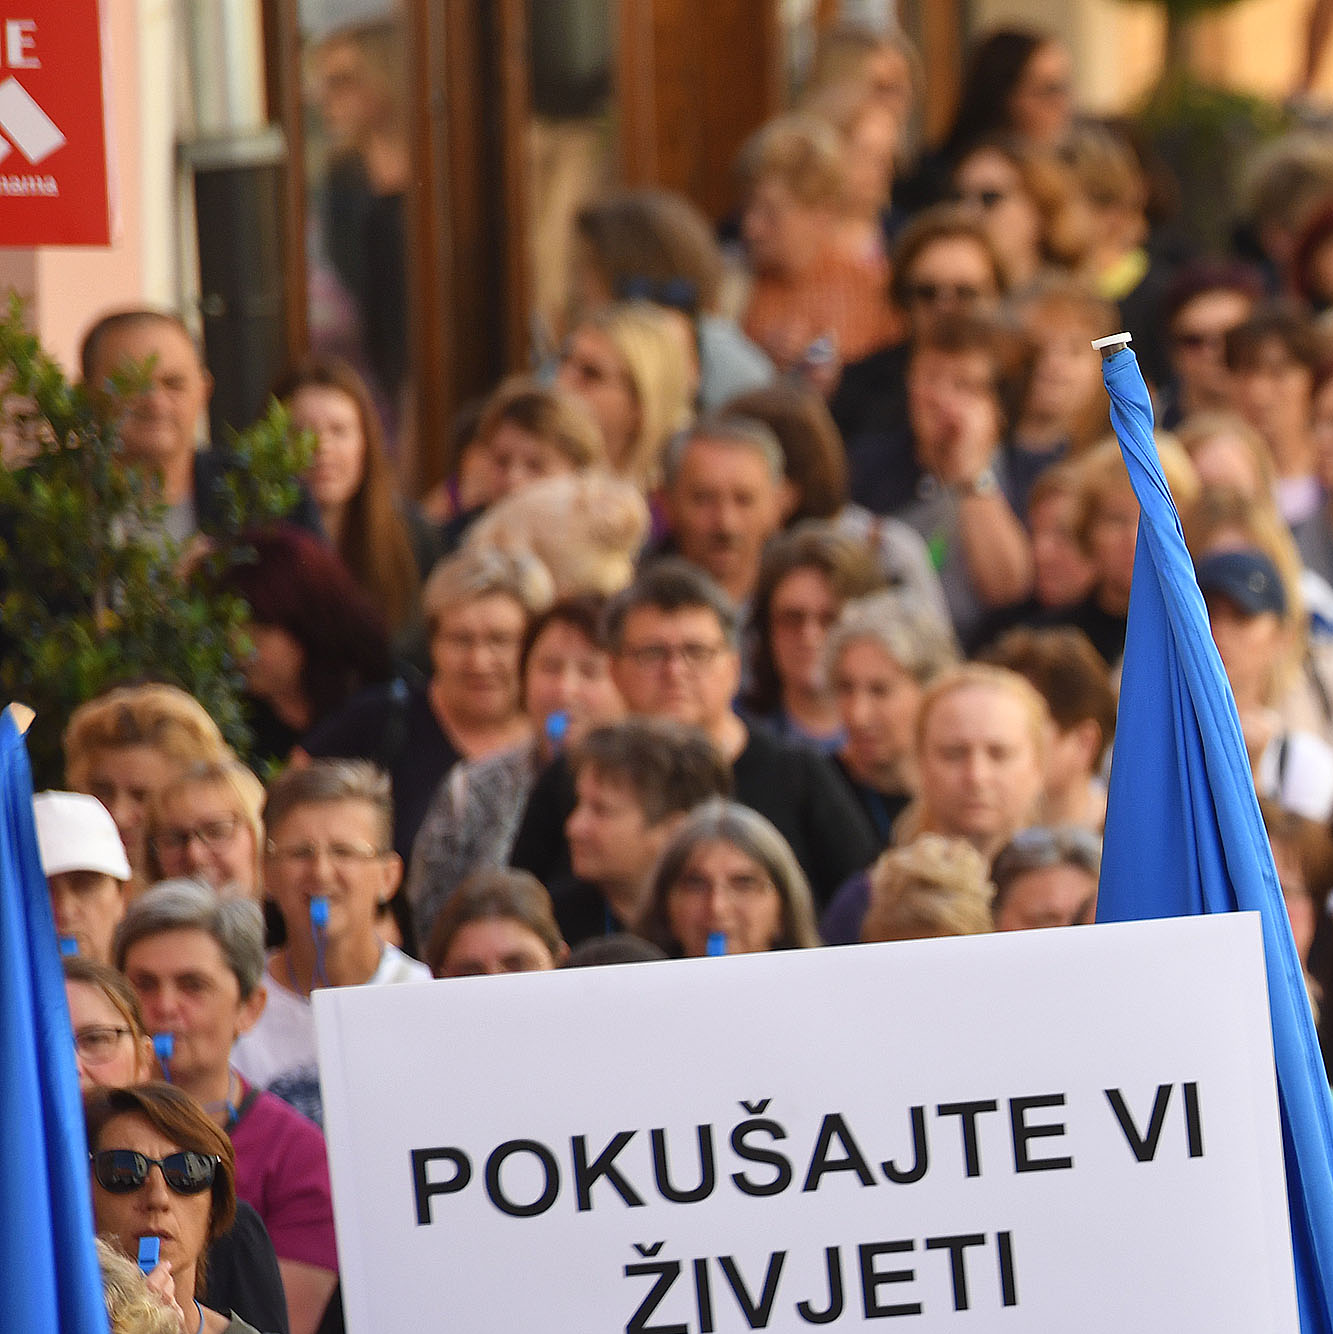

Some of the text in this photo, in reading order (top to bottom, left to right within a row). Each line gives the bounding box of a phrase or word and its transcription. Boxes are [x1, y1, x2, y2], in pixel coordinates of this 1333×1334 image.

[0, 18, 42, 69] E
[408, 1080, 1205, 1228] POKUŠAJTE VI
